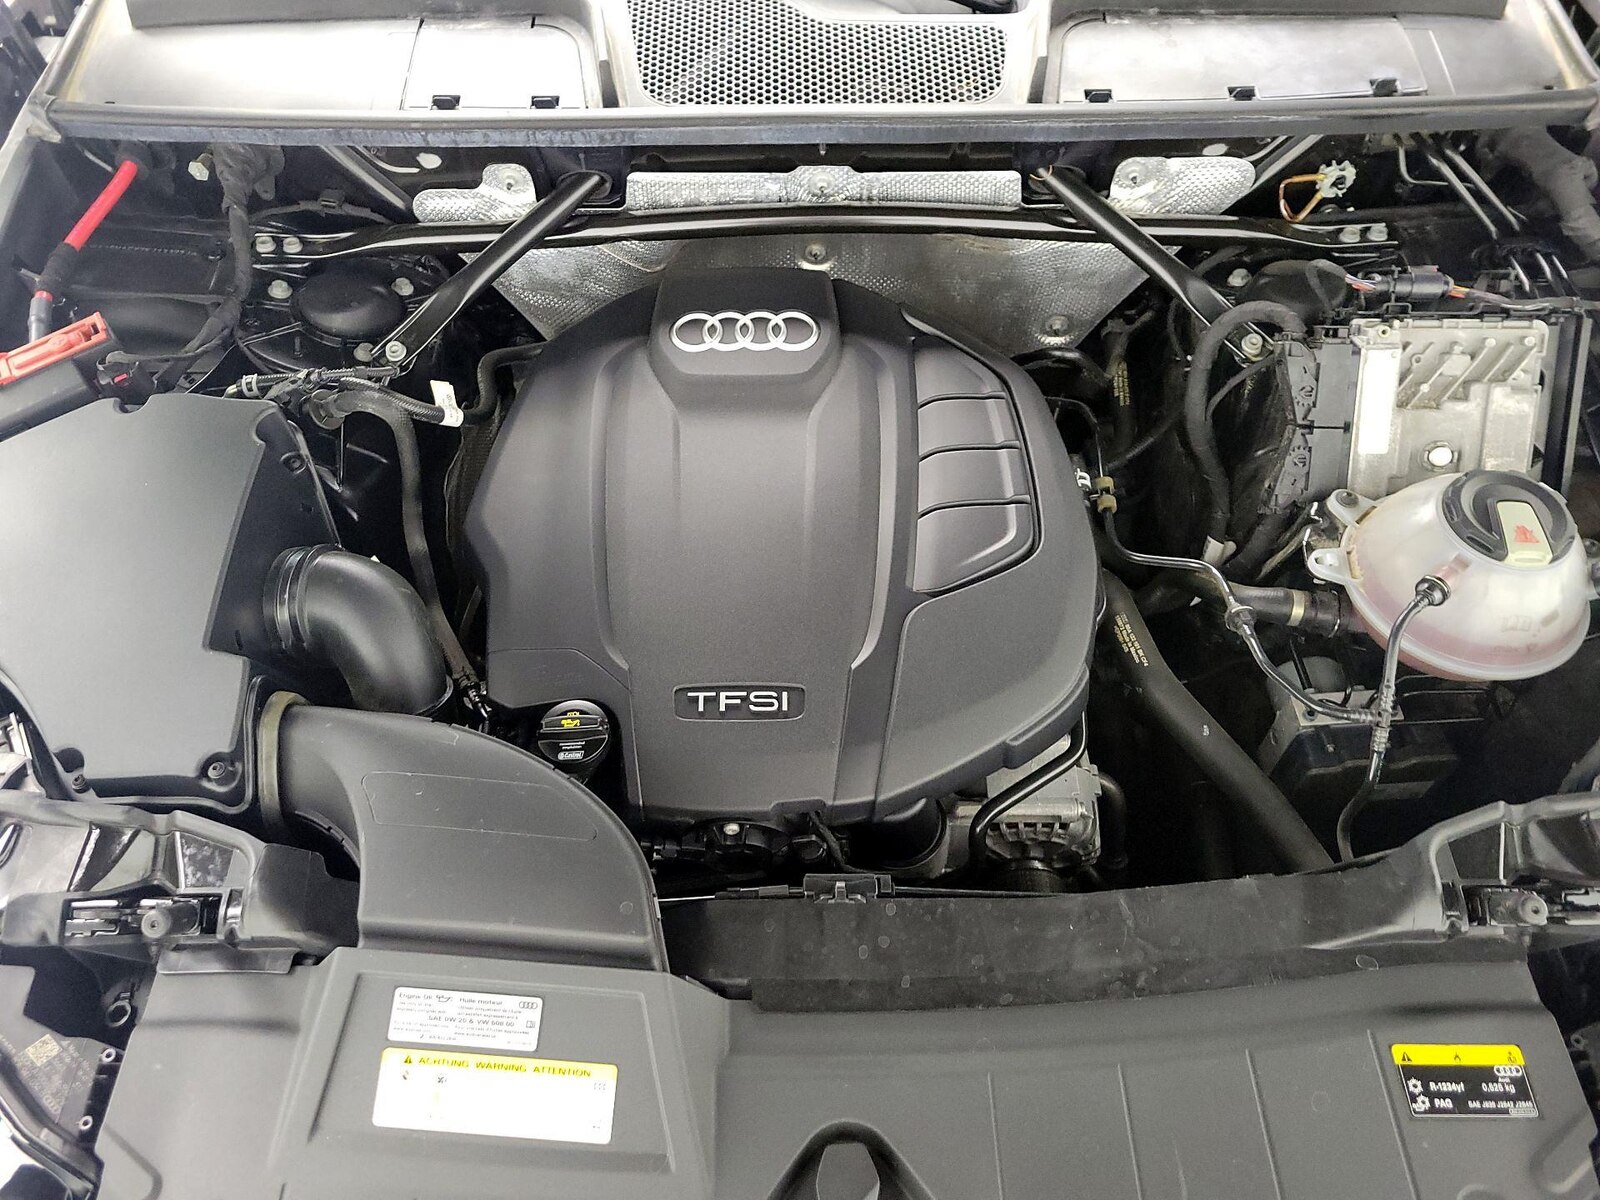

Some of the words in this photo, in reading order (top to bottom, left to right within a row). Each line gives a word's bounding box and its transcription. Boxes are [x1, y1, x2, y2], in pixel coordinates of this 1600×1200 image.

[687, 691, 788, 712] TFSI
[418, 1057, 469, 1068] ACHTUNG
[475, 1061, 527, 1073] WARNING
[533, 1066, 592, 1077] ATTENTION
[1434, 1098, 1454, 1108] PAG
